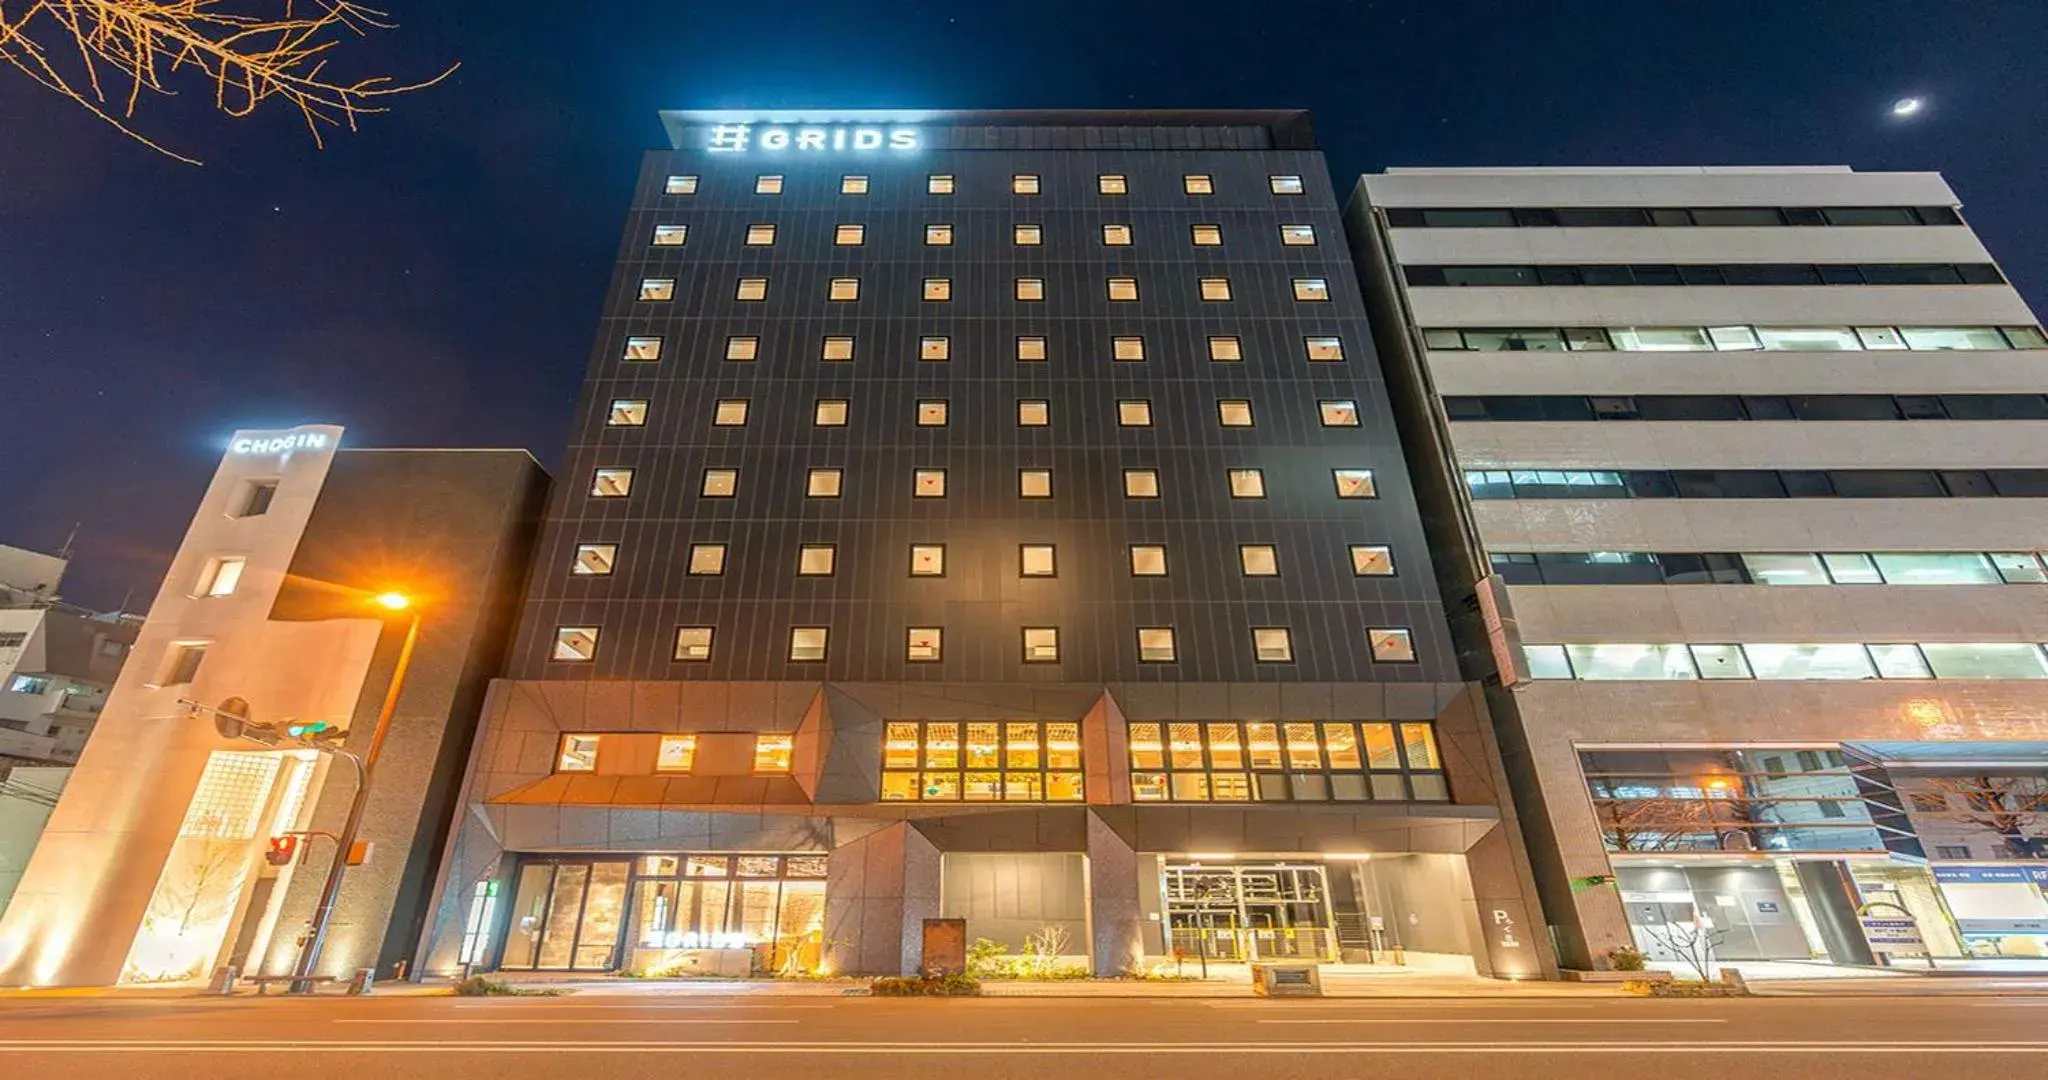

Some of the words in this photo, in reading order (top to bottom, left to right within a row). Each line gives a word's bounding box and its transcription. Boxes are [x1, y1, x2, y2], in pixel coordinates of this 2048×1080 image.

[761, 128, 918, 150] GRIDS
[234, 434, 327, 454] CHOSIN
[1493, 909, 1508, 924] P
